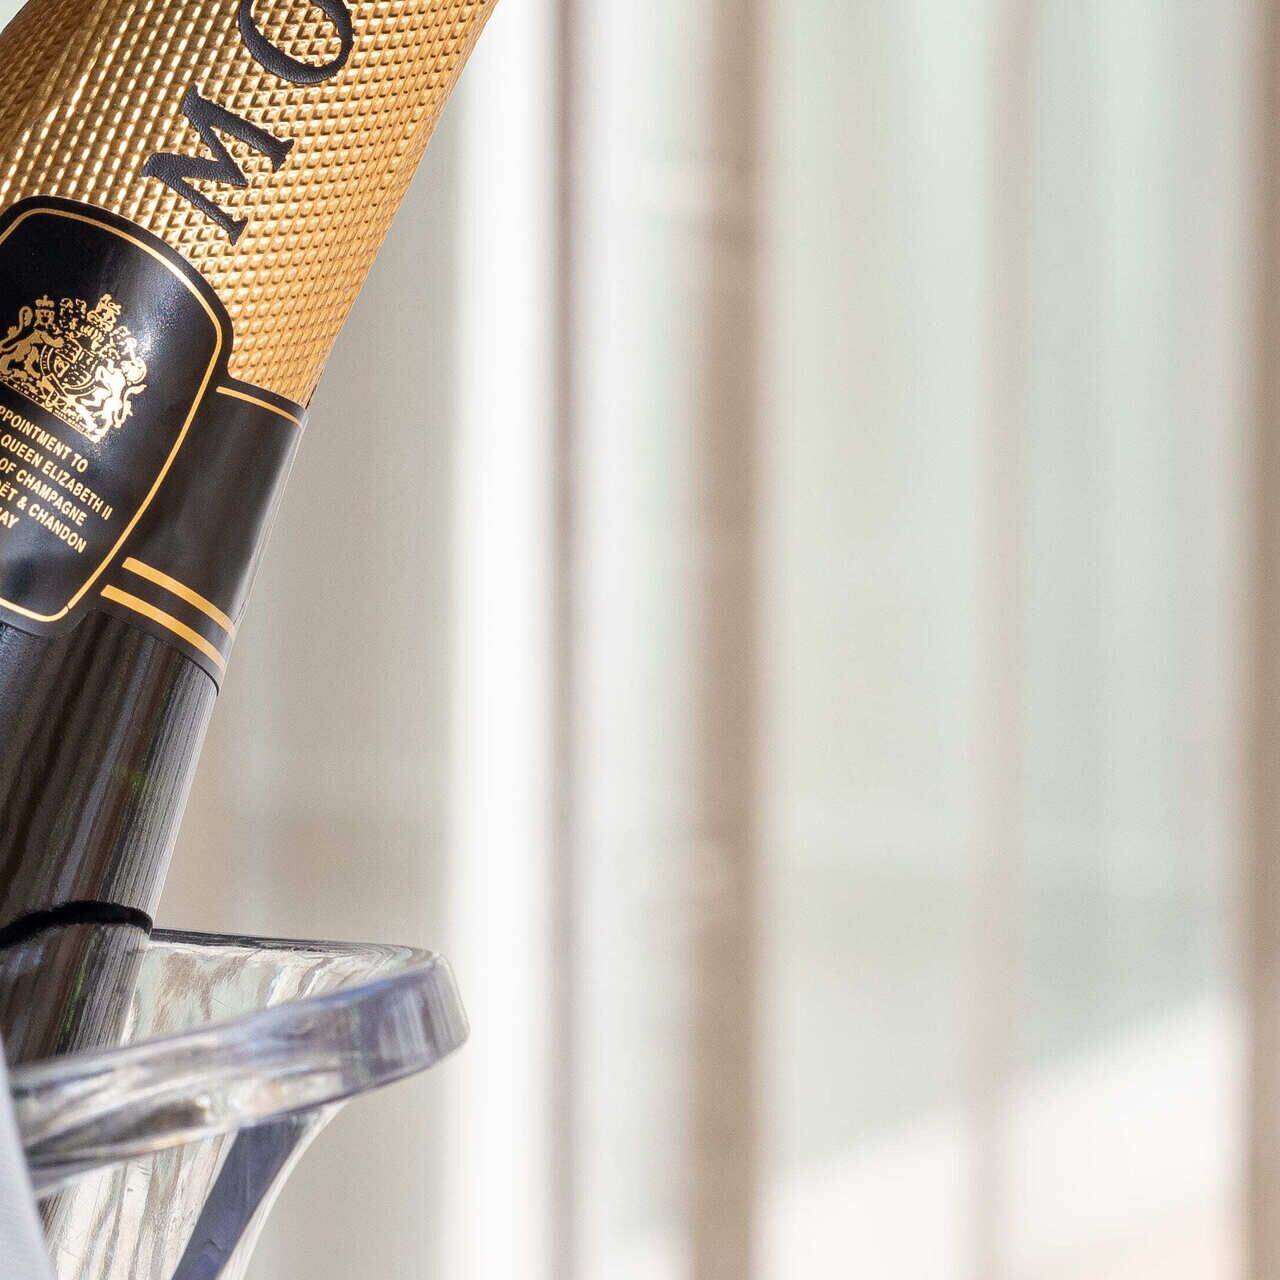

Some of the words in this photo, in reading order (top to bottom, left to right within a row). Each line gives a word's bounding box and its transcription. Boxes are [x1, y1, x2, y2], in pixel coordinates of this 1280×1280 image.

[1, 434, 43, 467] QUEEN
[43, 461, 104, 510] ELIZABETH
[101, 504, 112, 520] II
[72, 452, 88, 472] TO
[16, 470, 87, 526] CHAMPAGNE
[20, 497, 28, 510] &
[28, 504, 86, 554] CHANDON
